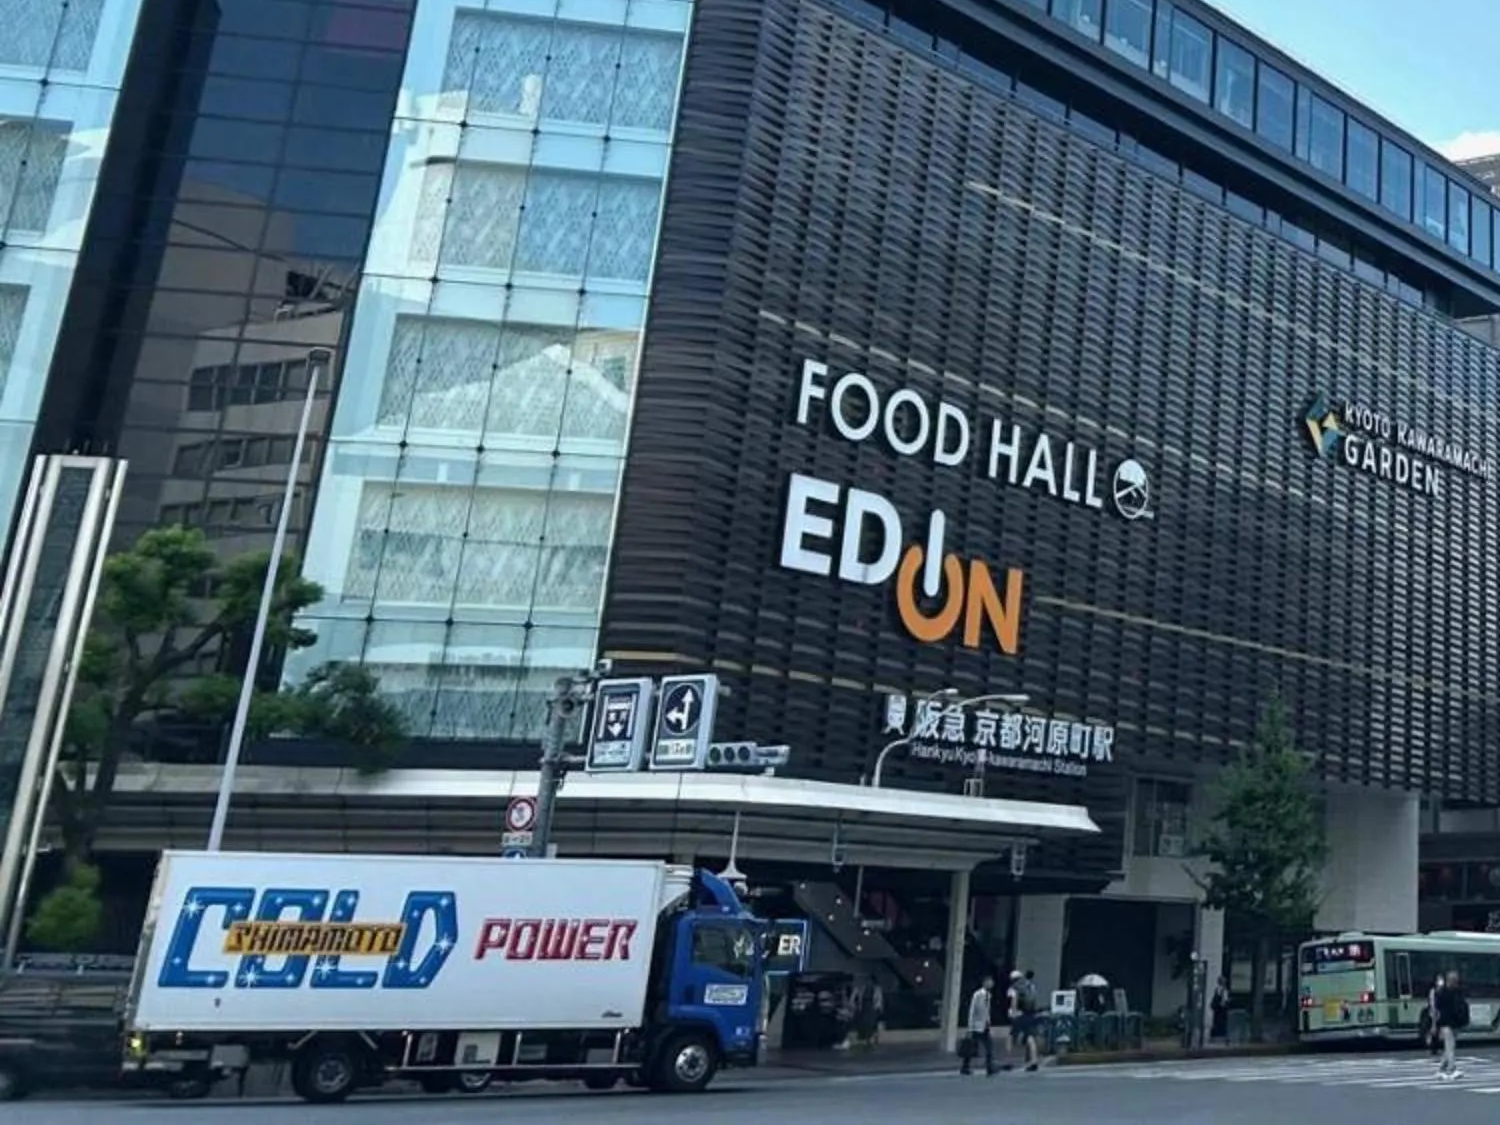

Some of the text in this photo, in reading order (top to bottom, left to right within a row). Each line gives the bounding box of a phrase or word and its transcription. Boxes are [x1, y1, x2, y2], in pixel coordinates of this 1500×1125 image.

[797, 358, 1103, 509] FOOD HALL
[1344, 400, 1494, 481] KYOTO KAWARAMACHI
[1344, 434, 1441, 496] GARDEN
[781, 472, 1023, 655] EDION
[910, 699, 1115, 762] 阪急 京都河原町駅
[911, 743, 1088, 777] Hankyu Kyo-kawaramachi Station
[158, 887, 459, 989] COLD
[223, 922, 406, 956] SHIMAMOTO
[473, 918, 638, 961] POWER
